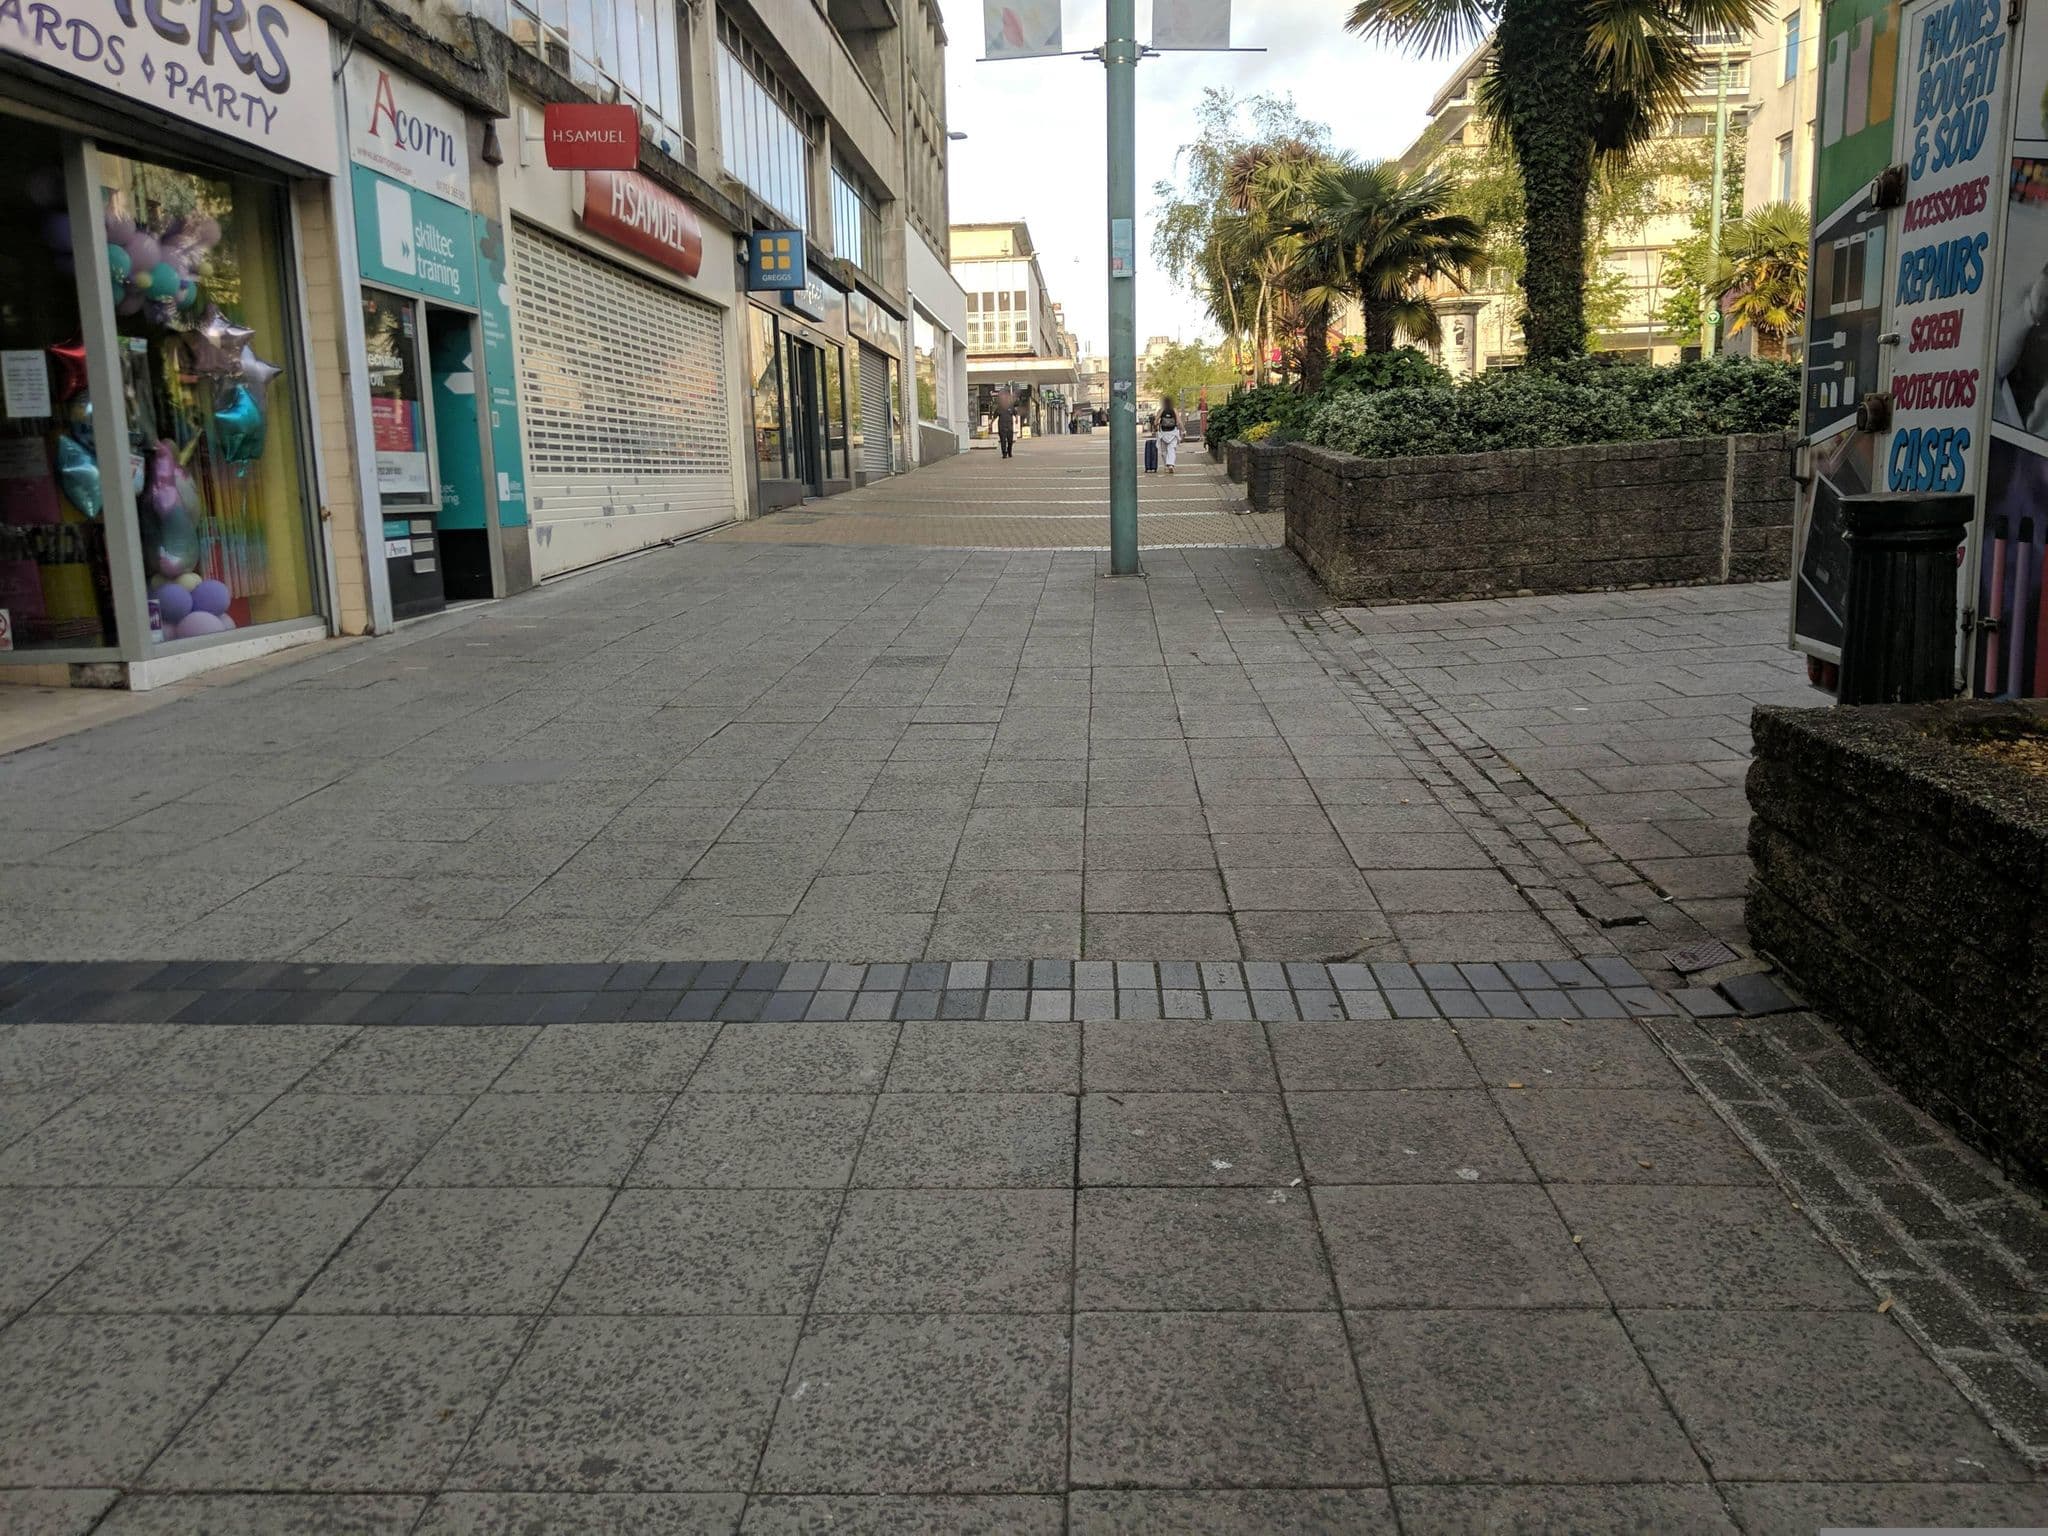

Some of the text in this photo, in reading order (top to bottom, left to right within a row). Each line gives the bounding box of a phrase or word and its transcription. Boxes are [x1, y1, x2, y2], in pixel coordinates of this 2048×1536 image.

[1918, 0, 2001, 72] PHONES
[165, 61, 278, 135] PARTY
[1914, 32, 2006, 128] BOUGHT
[368, 69, 457, 167] Acorn
[1911, 99, 1990, 182] & SOLD
[611, 171, 686, 253] H.SAMUEL
[1903, 175, 1990, 234] ACCESSORIES
[414, 220, 455, 259] skilltec
[1895, 231, 1989, 307] REPAIRS
[417, 253, 461, 296] training
[761, 273, 793, 282] GREGGS
[1909, 308, 1965, 353] SCREEN
[1892, 368, 1980, 411] PROTECTORS
[1888, 426, 1971, 493] CASES
